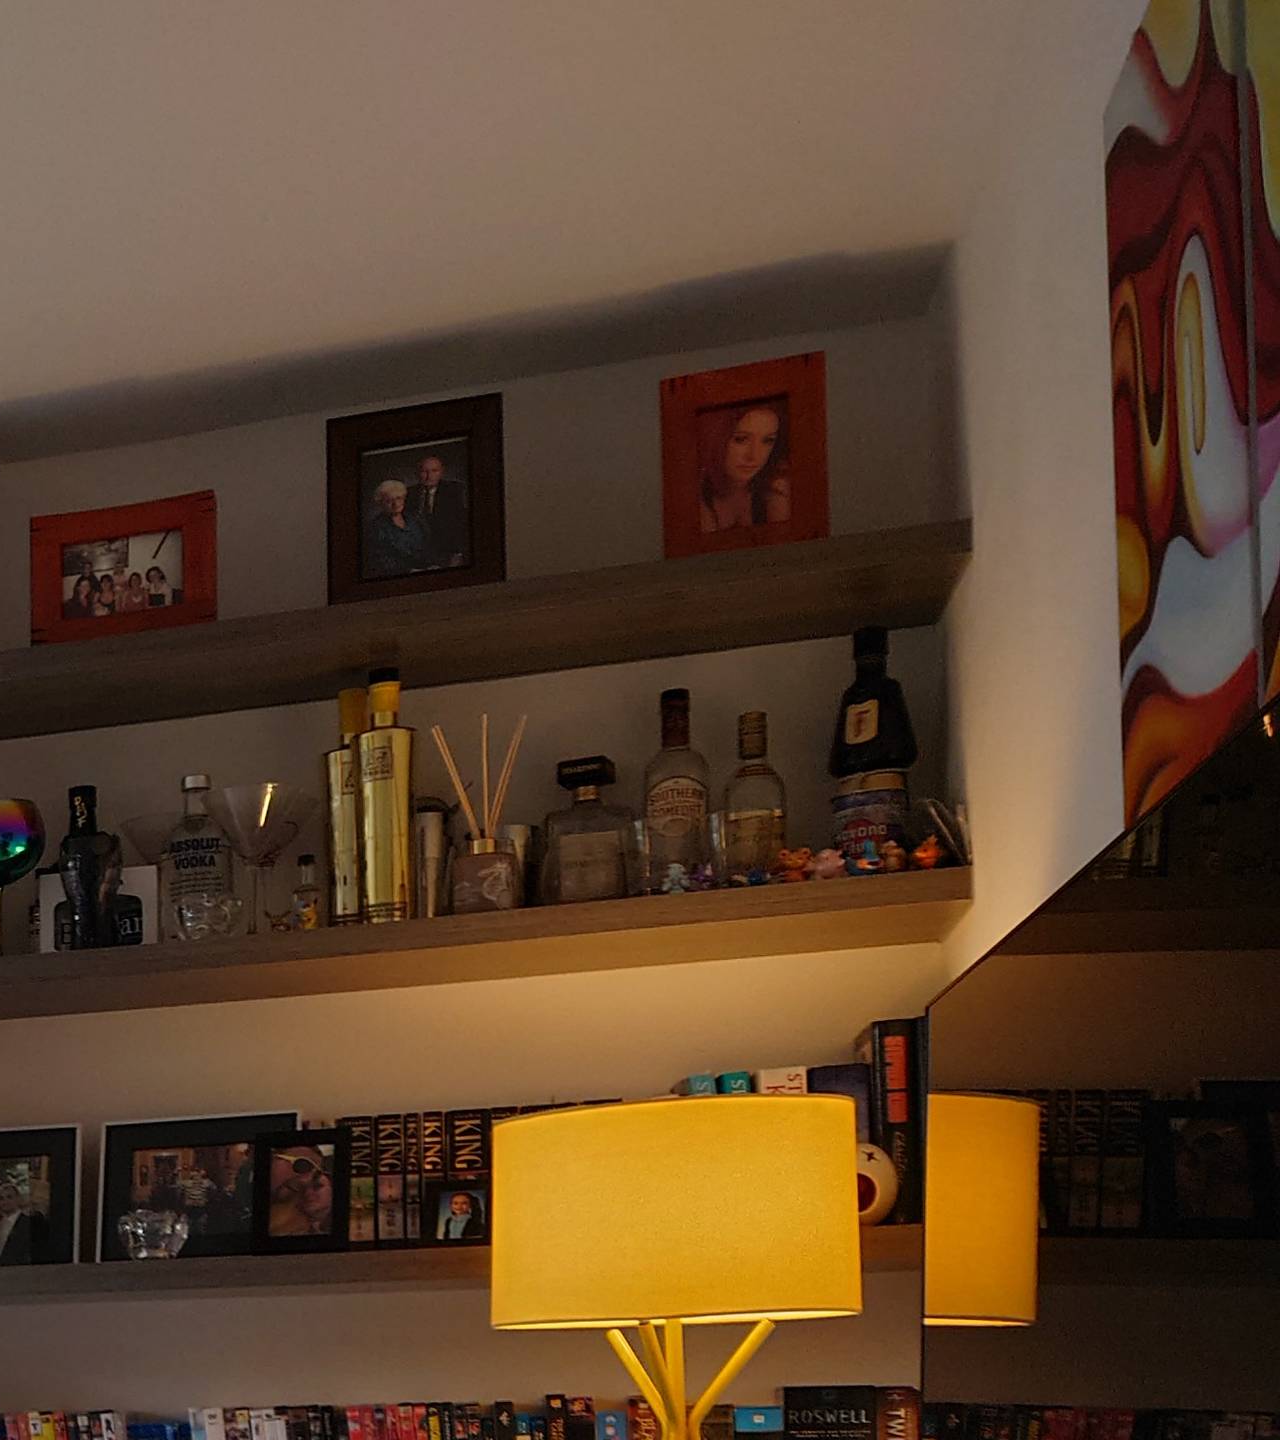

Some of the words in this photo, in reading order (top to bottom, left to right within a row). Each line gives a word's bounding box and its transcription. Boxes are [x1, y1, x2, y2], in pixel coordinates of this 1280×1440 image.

[169, 838, 221, 854] ABSOLUT
[175, 855, 217, 870] VODKA
[351, 1125, 372, 1175] KING
[377, 1123, 402, 1172] KING
[423, 1121, 443, 1171] KING
[453, 1119, 482, 1169] KING
[788, 1408, 873, 1425] ROSWELL
